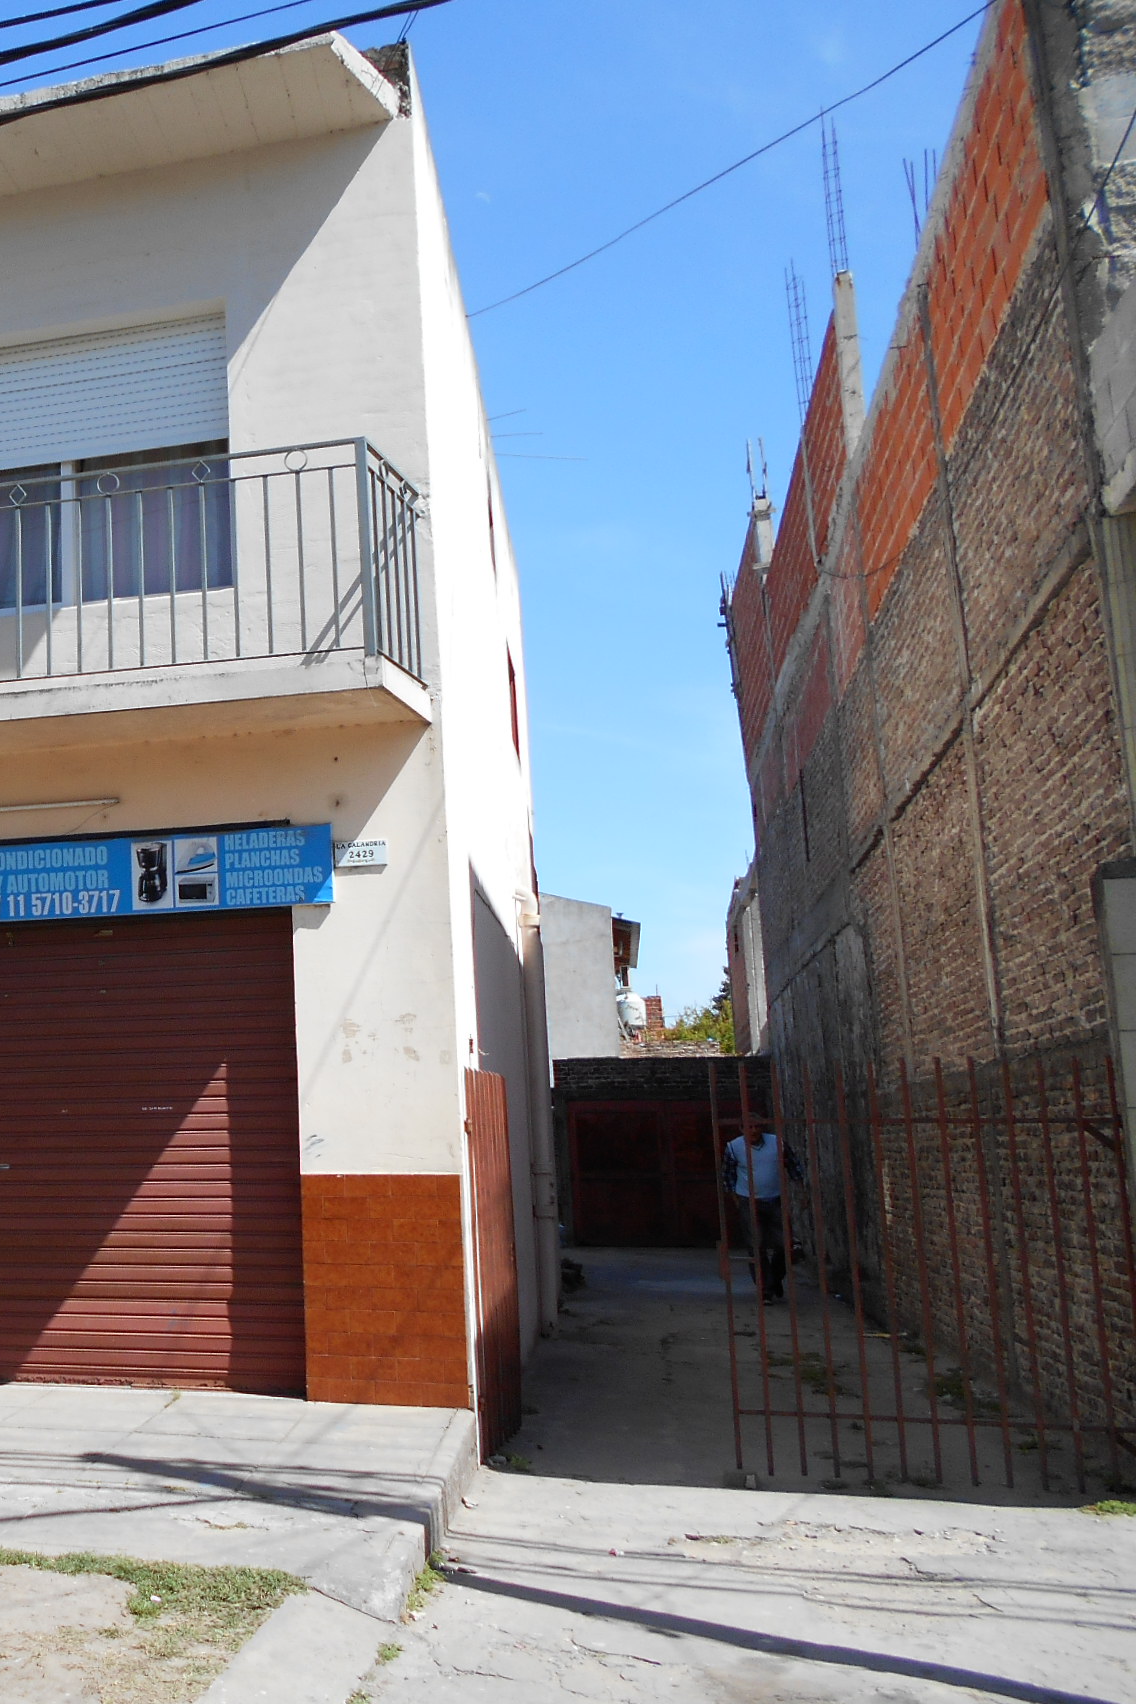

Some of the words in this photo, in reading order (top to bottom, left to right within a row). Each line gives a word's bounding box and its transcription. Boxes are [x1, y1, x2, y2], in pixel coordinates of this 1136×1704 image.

[224, 830, 306, 850] HELADERAS
[225, 849, 300, 869] PLANCHAS
[348, 850, 374, 858] 2429
[7, 869, 109, 894] AUTOMOTOR
[226, 866, 323, 888] MICROONDAS
[7, 894, 25, 917] 11
[31, 889, 121, 915] 5710-3717
[226, 885, 304, 905] CAFETERAS
